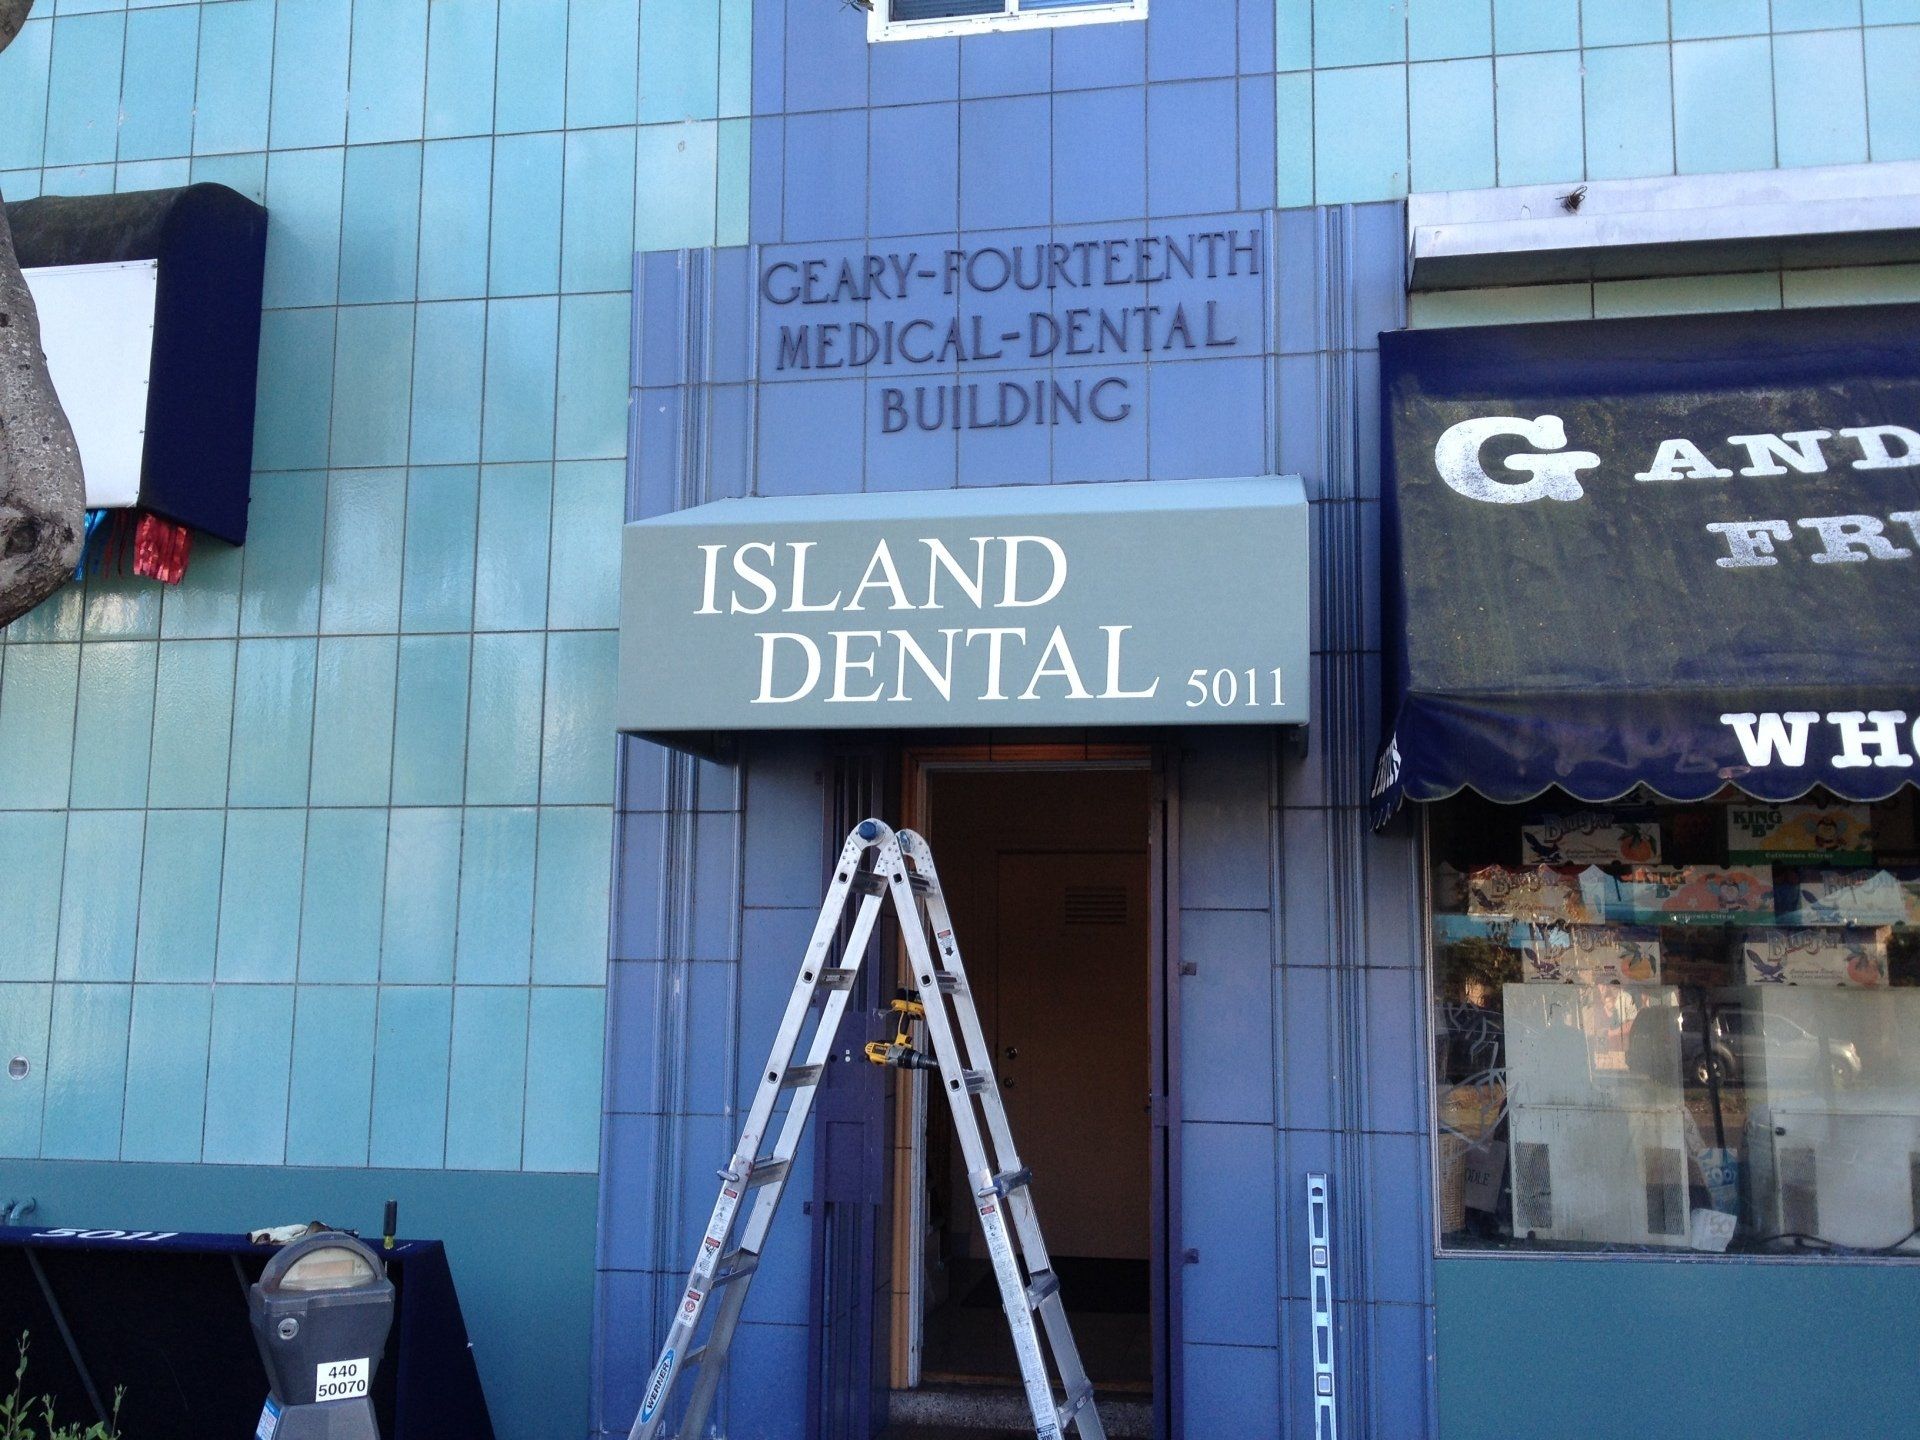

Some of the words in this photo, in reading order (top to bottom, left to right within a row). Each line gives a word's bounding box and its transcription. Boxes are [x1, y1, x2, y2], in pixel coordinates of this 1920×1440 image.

[761, 229, 1261, 304] GEARY-FOURTEENTH
[776, 301, 1237, 371] MEDICAL-DENTAL
[881, 377, 1131, 433] BUILDING
[693, 535, 1068, 615] ISLAND
[750, 624, 1160, 704] DENTAL
[1185, 667, 1287, 708] 5011
[1719, 710, 1920, 769] WH
[1732, 810, 1783, 825] KING
[31, 1228, 179, 1241] 5011
[318, 1379, 366, 1397] 50070
[328, 1364, 357, 1379] 440
[647, 1362, 669, 1409] WERNER
